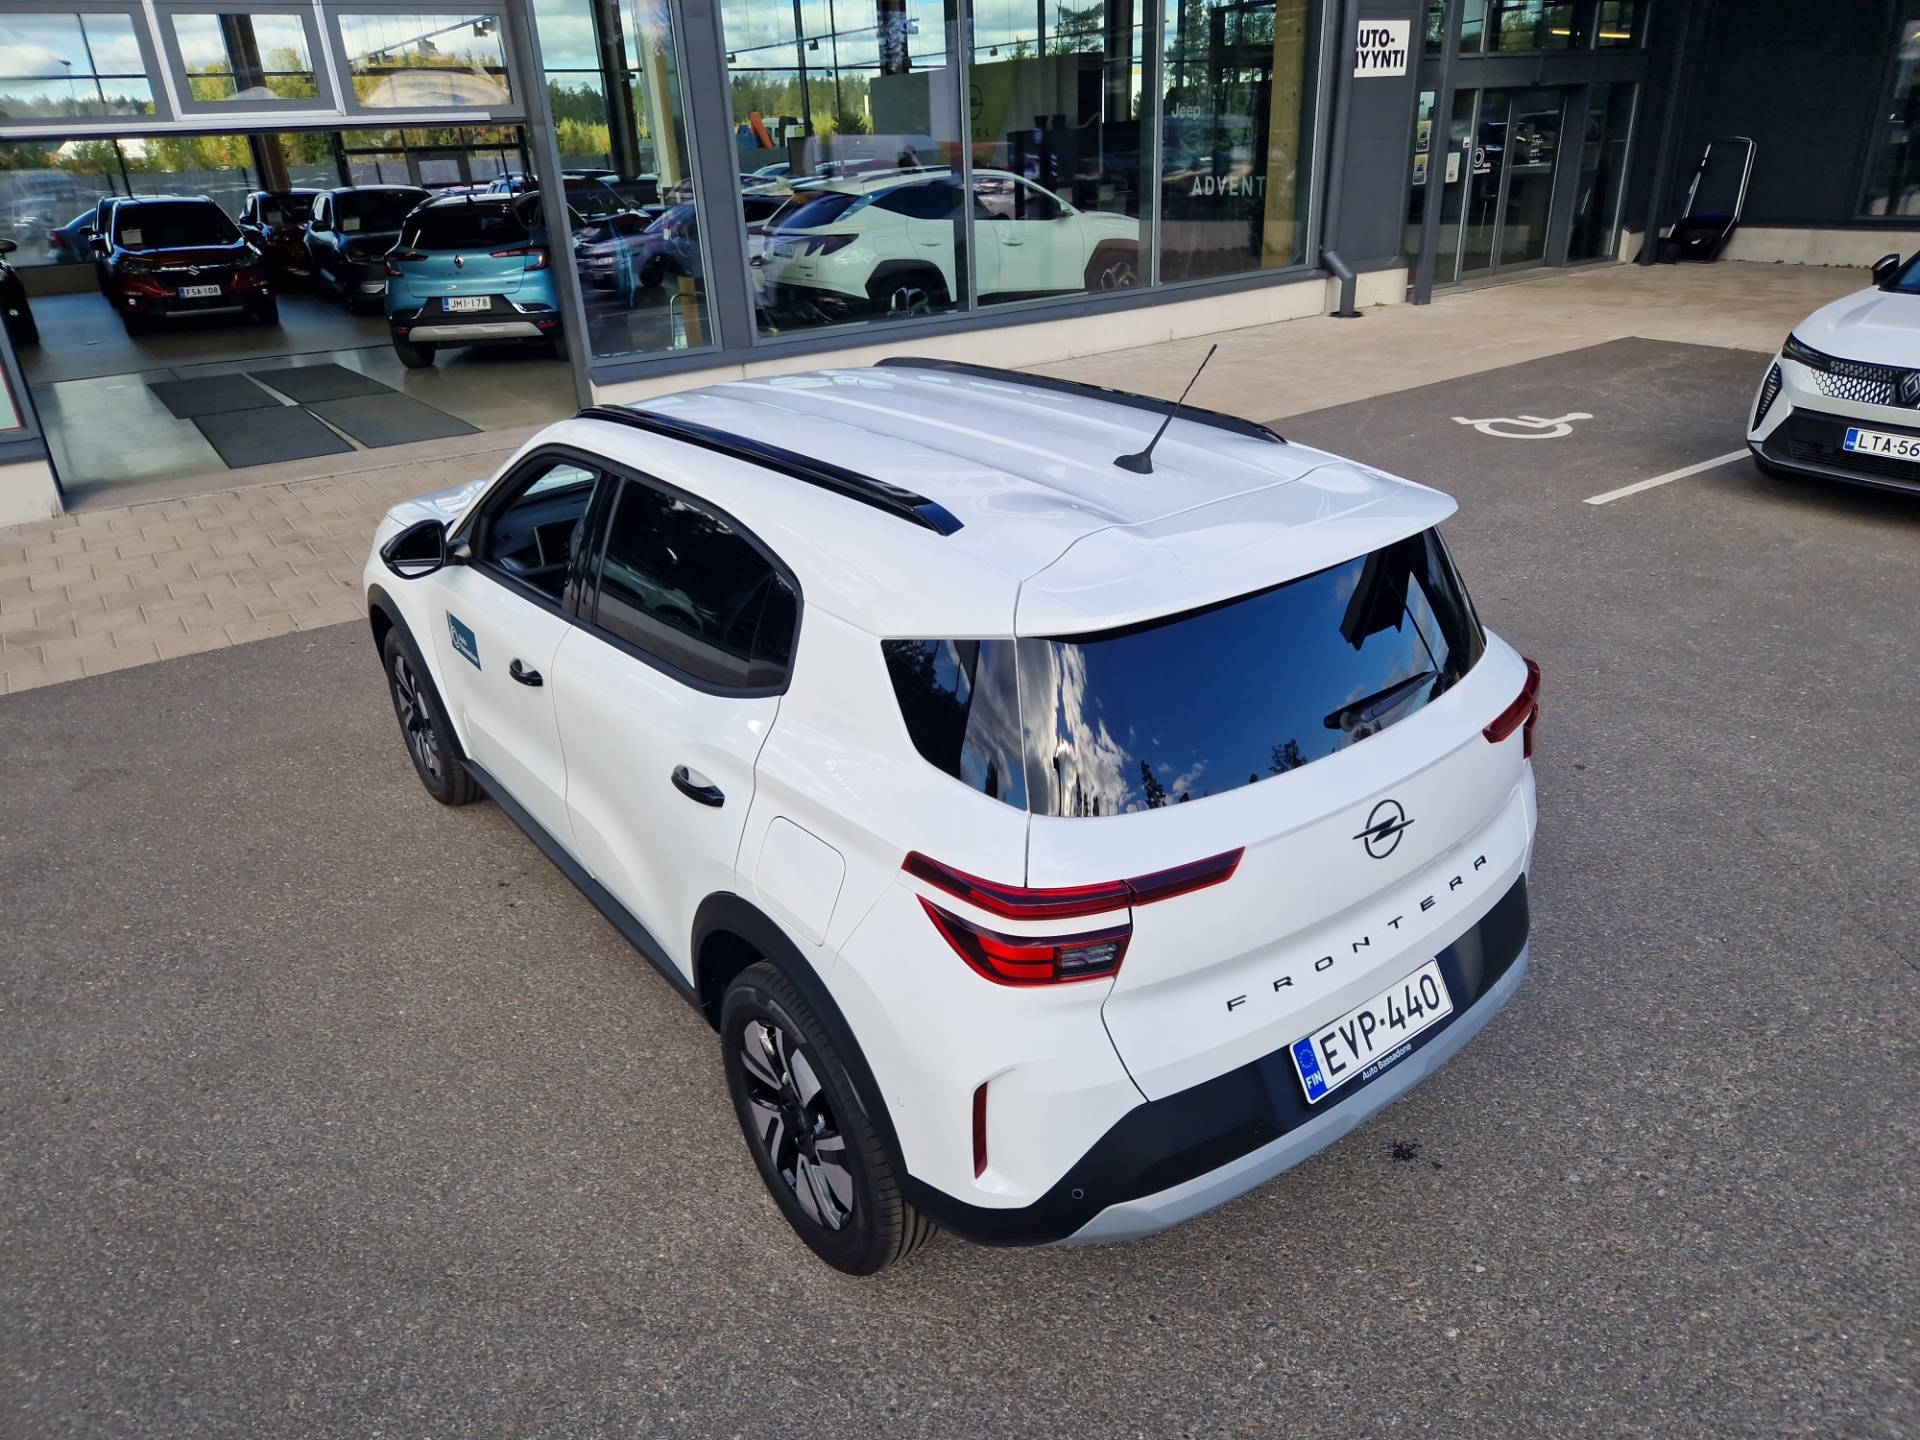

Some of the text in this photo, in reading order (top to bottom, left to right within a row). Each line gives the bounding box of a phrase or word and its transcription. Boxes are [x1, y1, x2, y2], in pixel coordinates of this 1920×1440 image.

[1357, 29, 1396, 49] UTO-
[1355, 50, 1405, 69] YYNTI
[1171, 102, 1201, 120] Jeep
[185, 286, 219, 297] FSA-108
[450, 298, 489, 309] JMI-178
[1226, 854, 1488, 1012] FRONTERA
[1318, 973, 1440, 1077] EVP-440
[1361, 1042, 1412, 1081] Auto Bassadone
[1305, 1070, 1323, 1090] FIN
